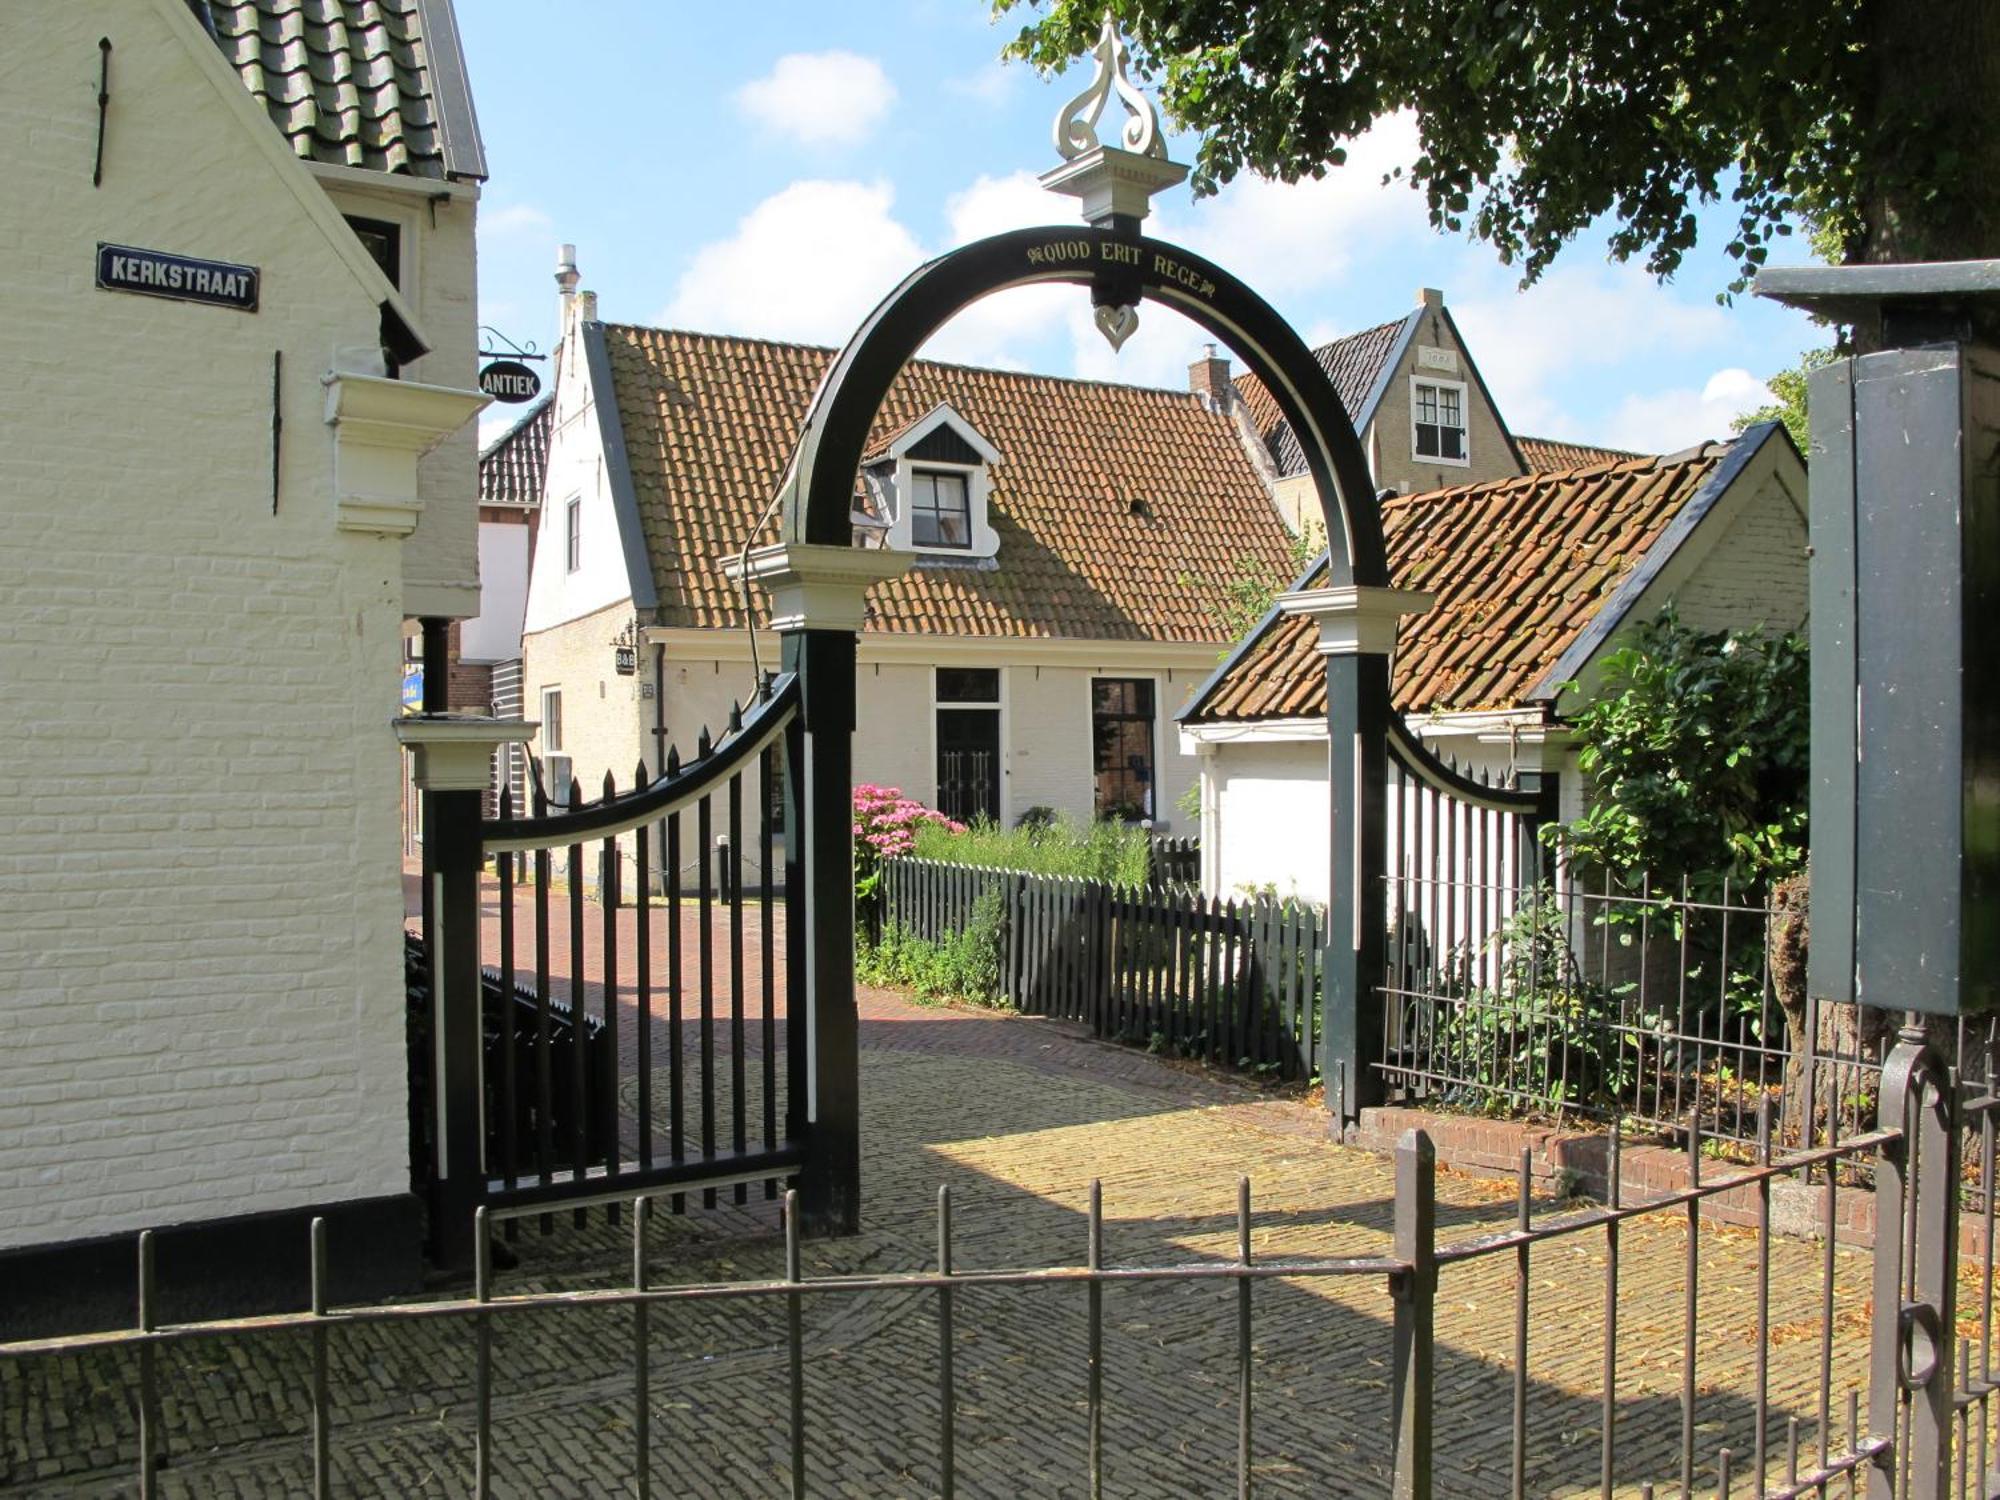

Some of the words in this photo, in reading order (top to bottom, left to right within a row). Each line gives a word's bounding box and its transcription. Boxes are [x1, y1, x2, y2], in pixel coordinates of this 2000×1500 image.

[111, 255, 249, 298] KERKSTRAAT
[1044, 241, 1091, 263] QUOD
[1101, 243, 1143, 265] ERIT
[1154, 255, 1200, 290] REGE
[483, 373, 537, 396] ANTIEK
[616, 653, 635, 666] B&B
